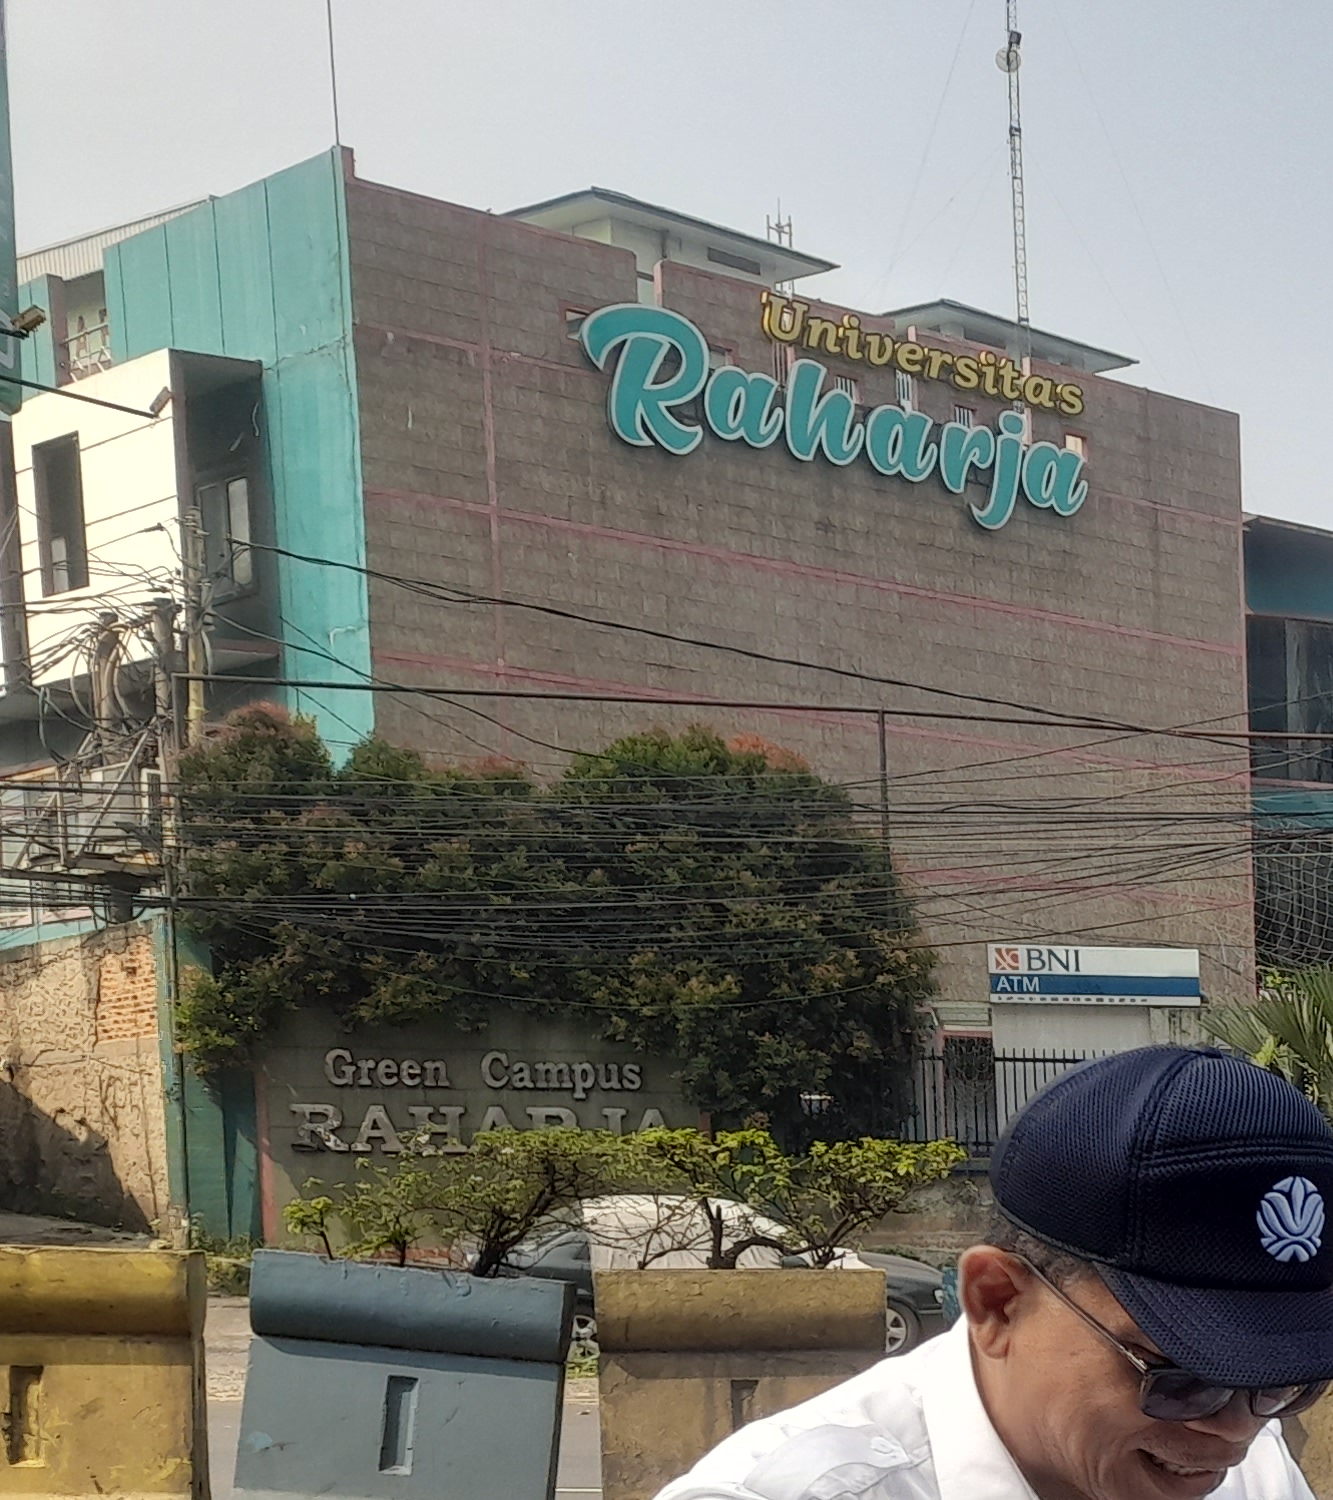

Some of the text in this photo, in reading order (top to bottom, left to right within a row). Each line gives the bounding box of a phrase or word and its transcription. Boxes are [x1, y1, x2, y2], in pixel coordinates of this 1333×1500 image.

[759, 290, 1085, 416] Universitas
[579, 301, 1088, 530] Raharja
[996, 976, 1040, 993] ATM
[1026, 948, 1081, 973] BNI
[324, 1047, 643, 1100] Green Campus
